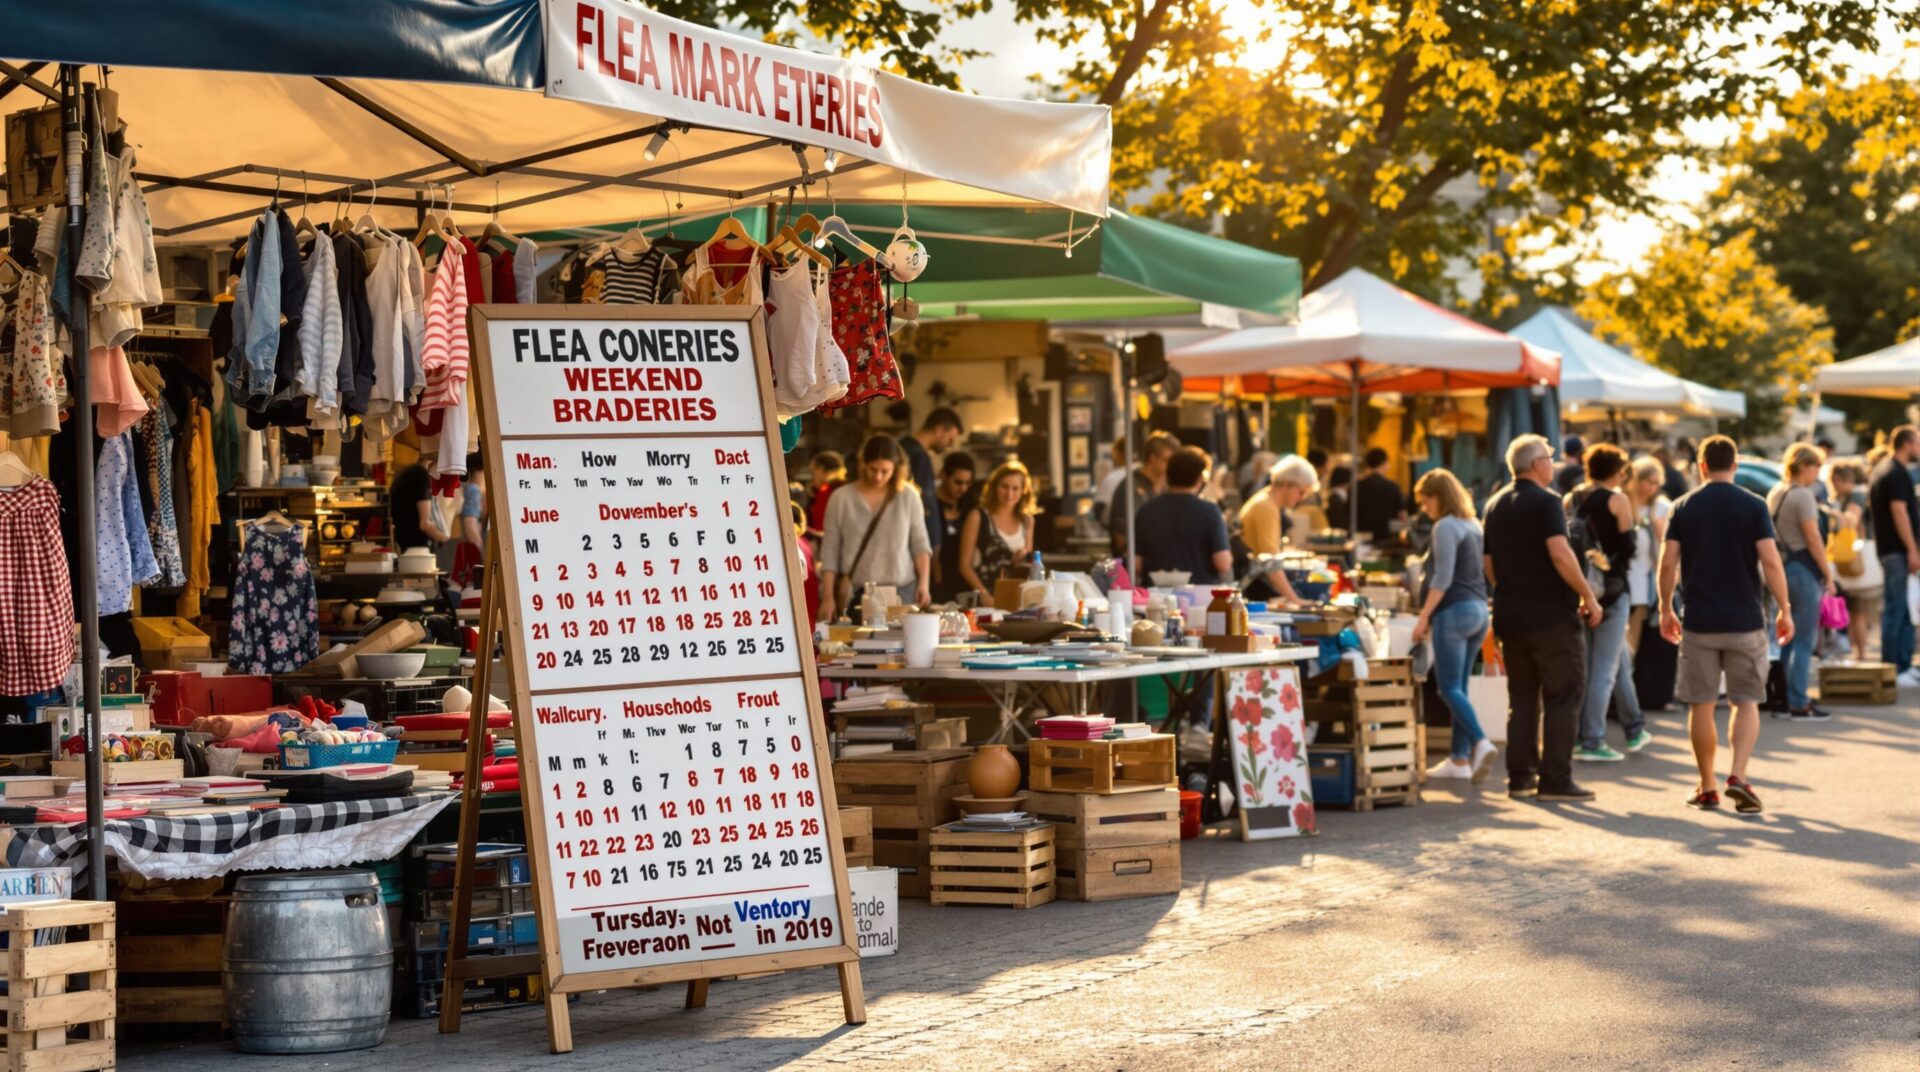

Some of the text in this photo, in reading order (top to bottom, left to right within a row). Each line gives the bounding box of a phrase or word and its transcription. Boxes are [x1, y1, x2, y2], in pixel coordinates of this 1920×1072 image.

[576, 2, 661, 90] FLEA
[669, 32, 766, 117] MARK
[512, 328, 739, 363] FLEA CONERIES
[563, 367, 703, 392] WEEKEND
[553, 397, 717, 423] BRADERIES
[581, 451, 616, 468] How
[646, 450, 690, 469] Morry
[714, 449, 750, 465] Dact
[520, 507, 559, 524] June
[722, 501, 730, 517] 1
[749, 500, 759, 517] 2
[525, 539, 539, 554] M
[582, 534, 592, 551] 2
[612, 533, 622, 550] 3
[640, 533, 650, 549] 5
[669, 532, 679, 547] 6
[697, 530, 705, 546] F
[754, 528, 762, 544] 1
[530, 554, 768, 582] 1 2 3 4 5 7 8 10 11
[532, 594, 543, 612] 9
[556, 592, 574, 610] 10
[586, 590, 605, 608] 14
[615, 589, 631, 606] 11
[642, 587, 661, 605] 12
[671, 586, 688, 603] 11
[729, 582, 746, 599] 11
[757, 581, 775, 598] 10
[532, 608, 778, 640] 21 13 20 17 18 18 25 28 21
[536, 637, 784, 669] 20 24 25 28 29 12 26 25 25
[737, 690, 780, 709] Frout
[548, 756, 562, 771] M
[573, 757, 586, 770] m
[685, 743, 693, 760] 1
[712, 741, 722, 758] 8
[738, 739, 748, 756] 7
[766, 737, 776, 754] 5
[553, 783, 561, 800] 1
[576, 781, 587, 799] 2
[603, 778, 614, 796] 8
[632, 776, 642, 793] 6
[659, 773, 669, 789] 7
[714, 768, 724, 785] 7
[739, 766, 757, 783] 18
[769, 763, 780, 780] 9
[792, 762, 809, 779] 18
[556, 790, 815, 829] 1 10 11 11 12 10 11 18 17 18
[556, 818, 819, 859] 11 22 22 23 20 23 25 24 25 26
[566, 847, 822, 889] 7 10 21 16 75 21 25 24 20 25
[696, 914, 733, 936] Not
[735, 898, 811, 922] Ventory
[756, 924, 776, 945] in
[785, 918, 833, 942] 2019
[858, 918, 872, 932] to
